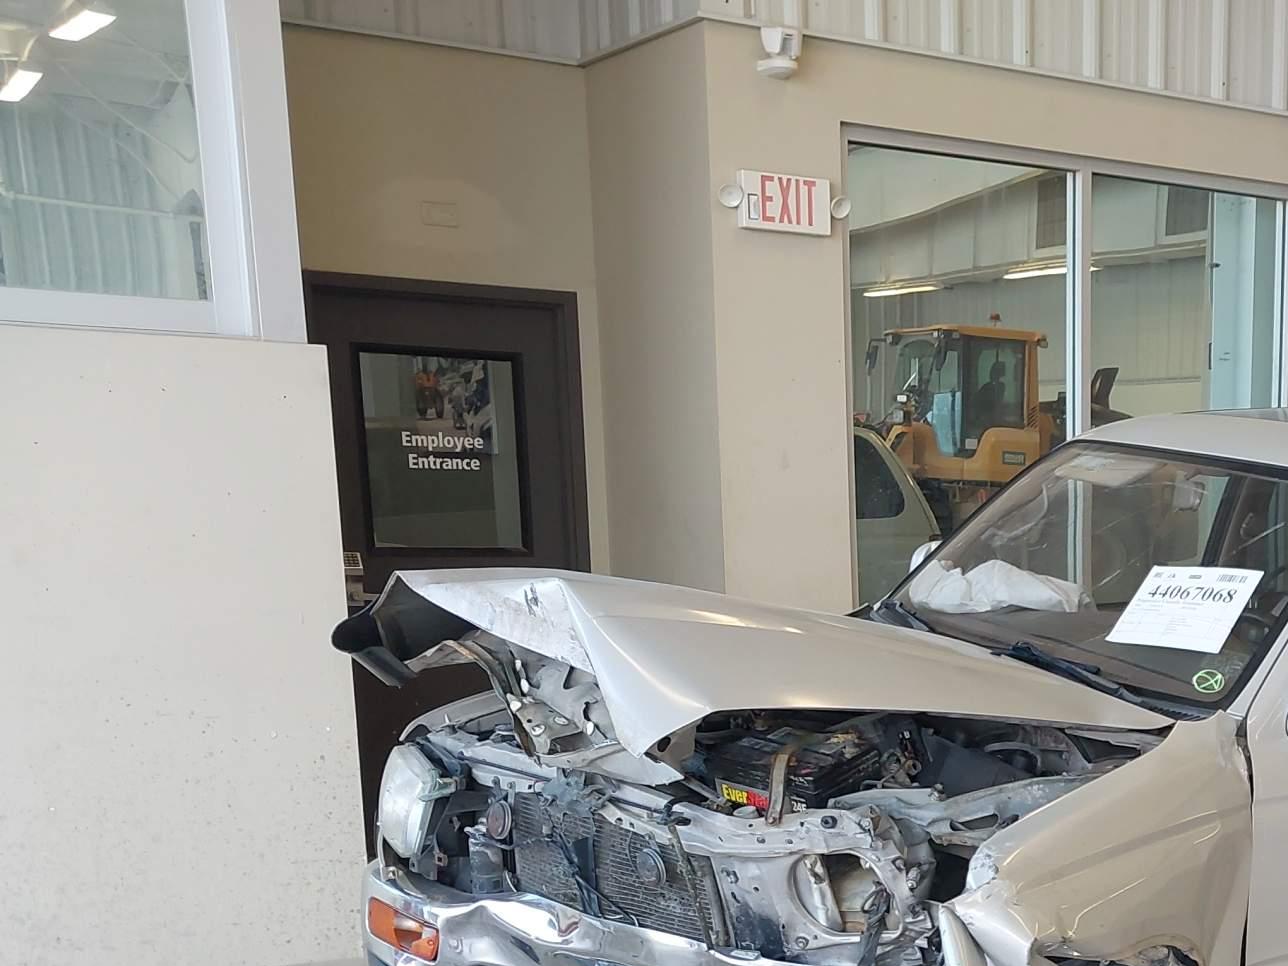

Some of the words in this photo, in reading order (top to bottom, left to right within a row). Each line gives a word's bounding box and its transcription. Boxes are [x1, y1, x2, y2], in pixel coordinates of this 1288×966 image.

[760, 174, 817, 227] EXIT
[401, 431, 484, 452] Employee
[408, 453, 481, 471] Entrance
[1147, 583, 1238, 604] 44067068
[721, 783, 769, 809] EverSta
